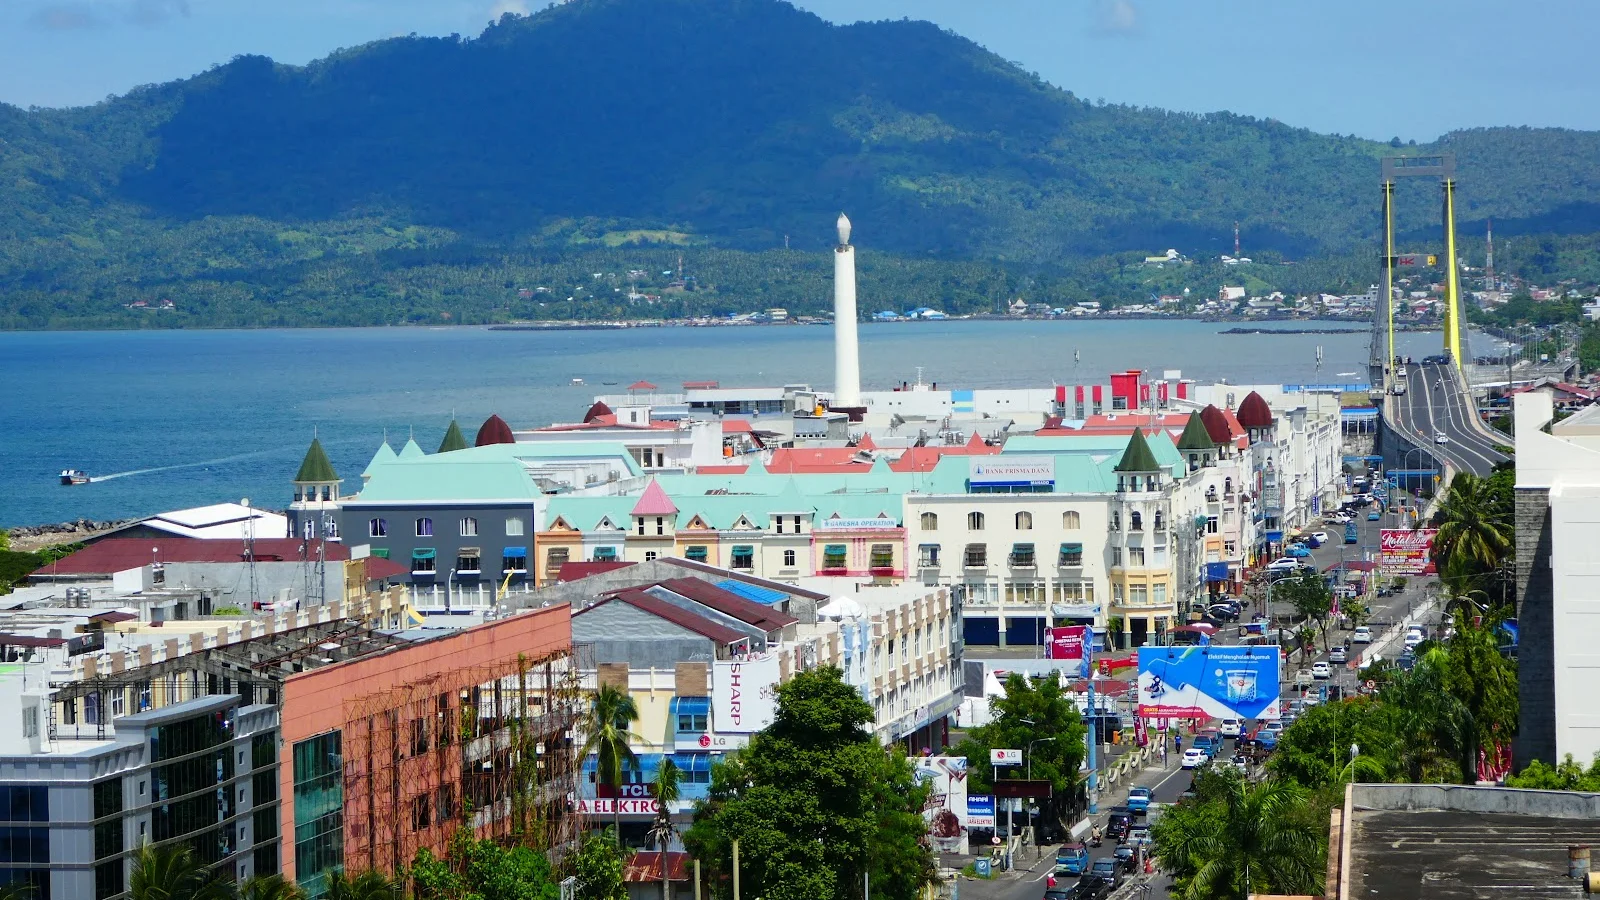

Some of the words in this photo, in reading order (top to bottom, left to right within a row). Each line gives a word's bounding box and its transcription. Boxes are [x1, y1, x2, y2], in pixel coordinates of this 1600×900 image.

[1382, 533, 1411, 548] Natal
[730, 663, 741, 726] SHARP
[713, 738, 726, 746] LG
[620, 784, 653, 797] TCL
